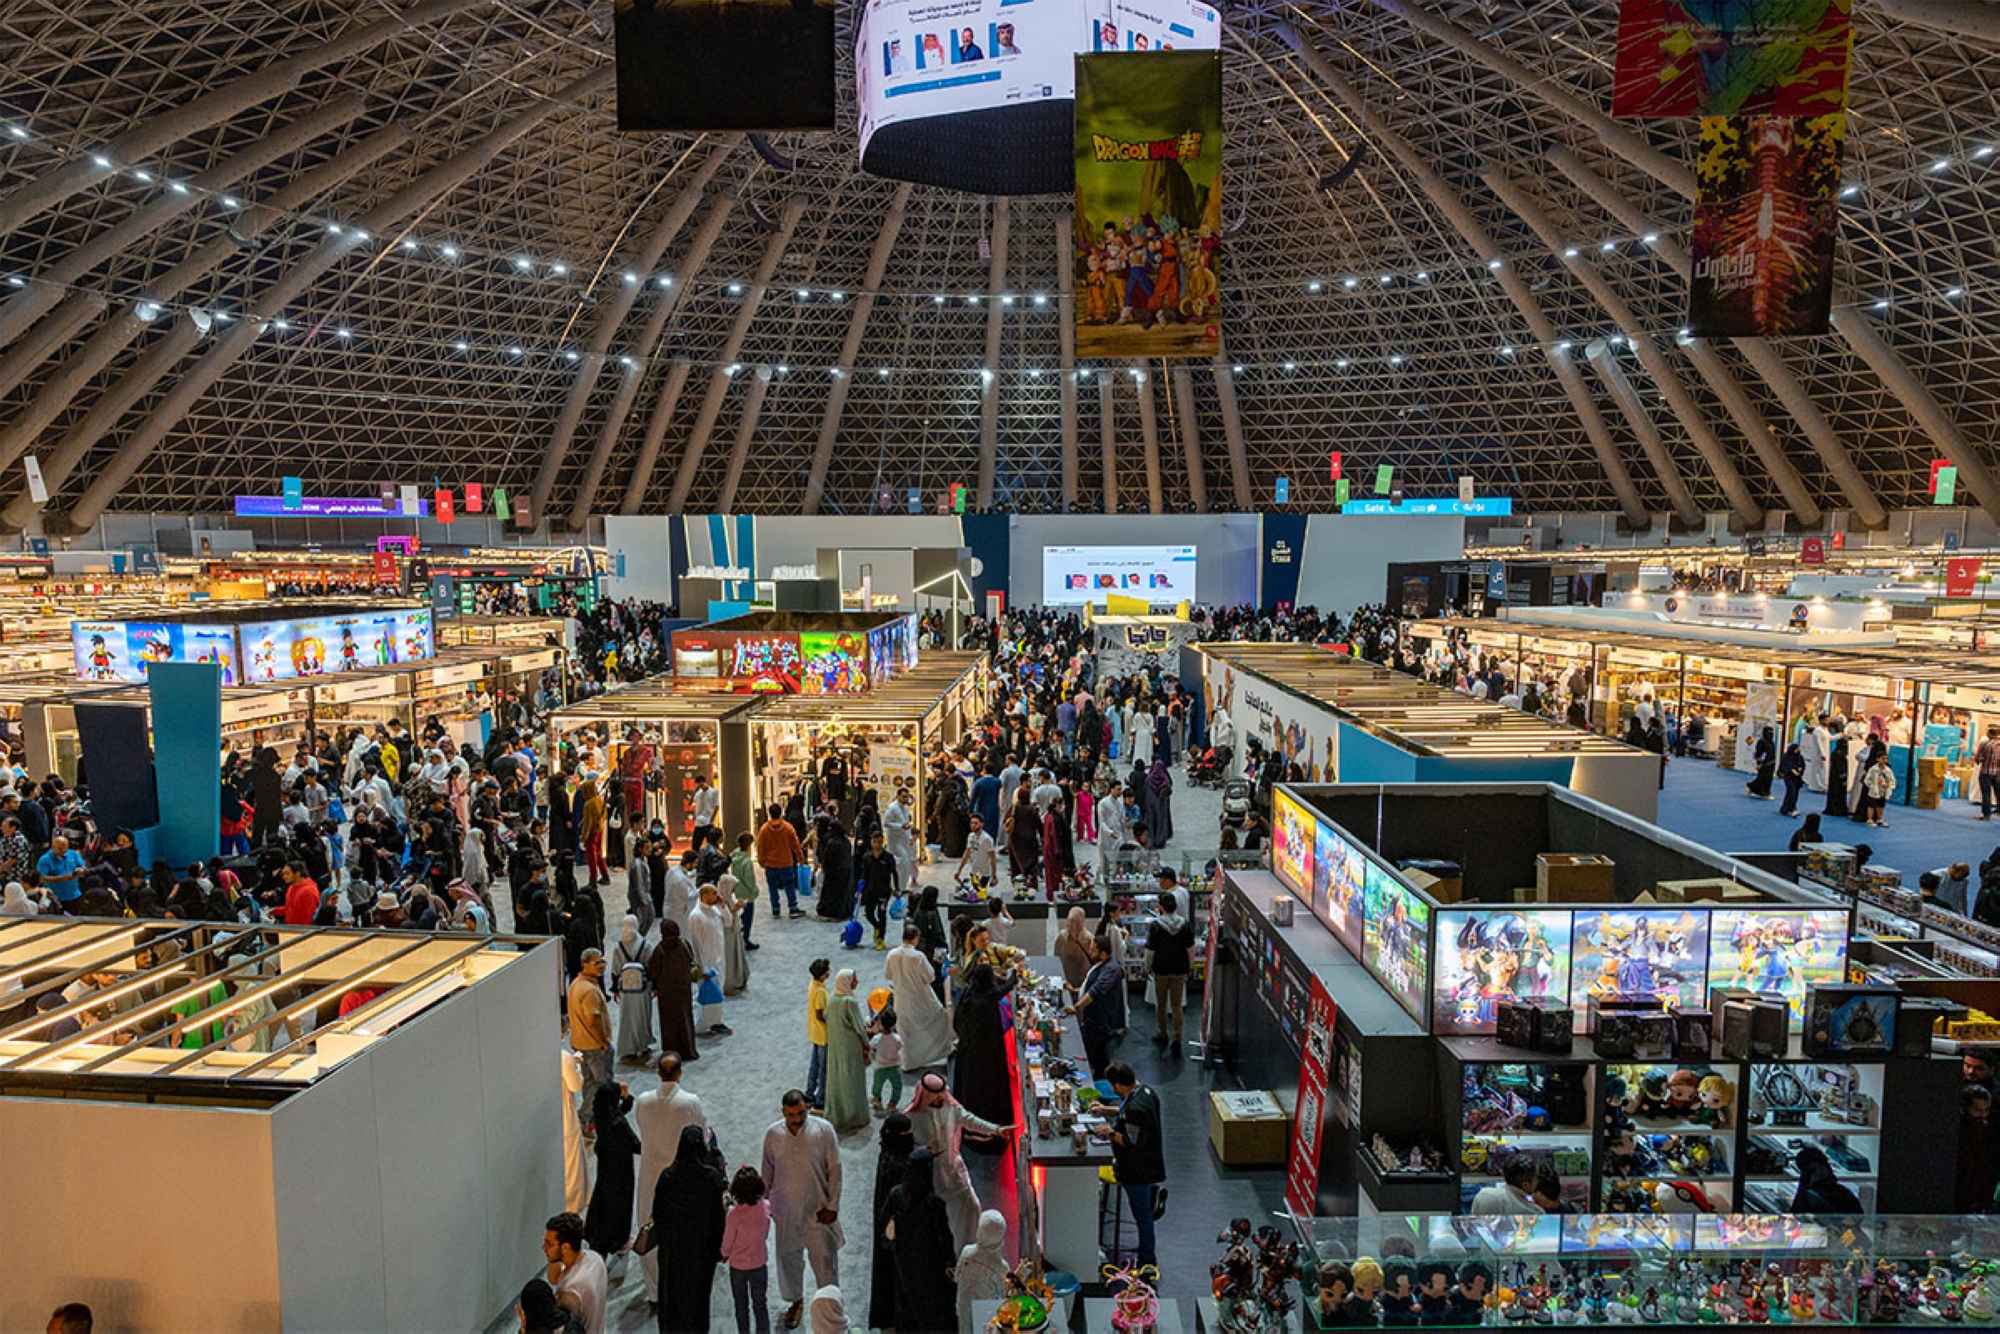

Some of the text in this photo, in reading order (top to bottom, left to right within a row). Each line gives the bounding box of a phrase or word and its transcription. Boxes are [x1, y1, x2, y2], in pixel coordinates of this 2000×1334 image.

[1364, 503, 1384, 512] Gate
[381, 558, 389, 568] D
[414, 565, 422, 577] C
[438, 584, 447, 598] B
